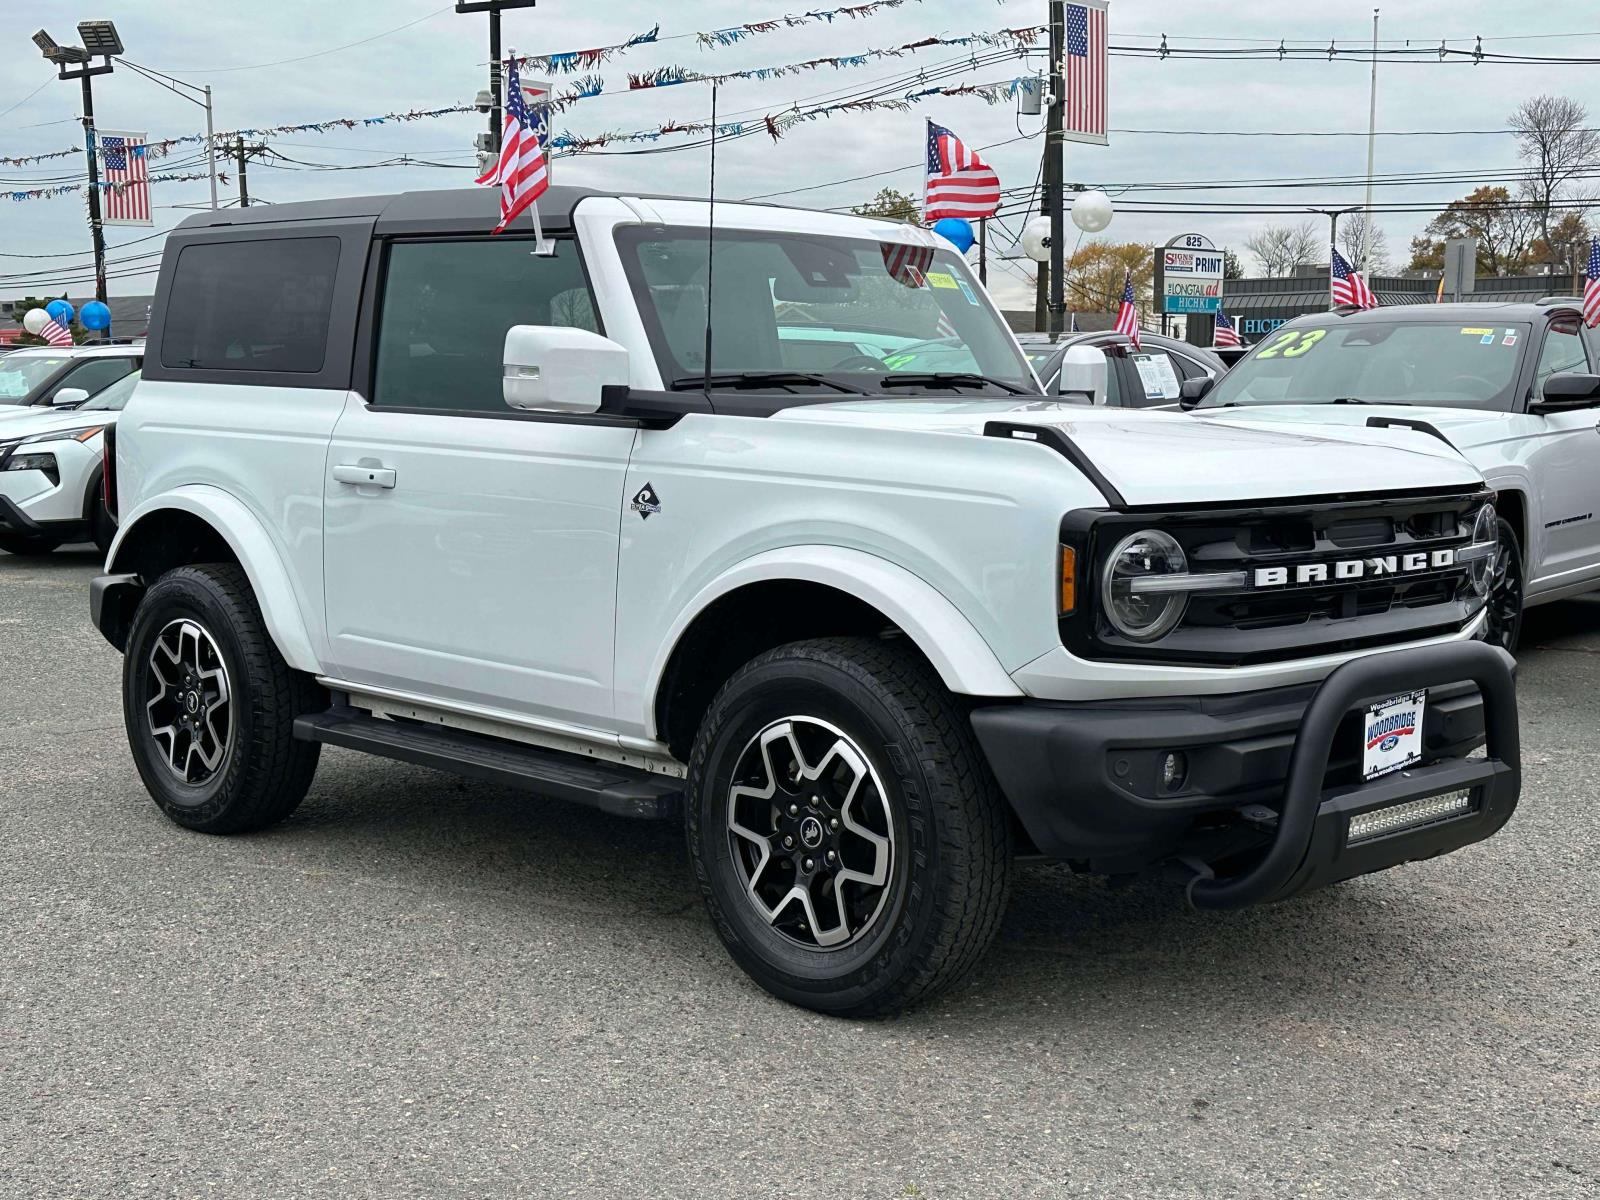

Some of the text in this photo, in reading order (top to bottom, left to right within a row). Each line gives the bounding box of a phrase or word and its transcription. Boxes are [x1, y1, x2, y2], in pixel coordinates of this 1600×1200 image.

[1186, 236, 1202, 247] 825
[1166, 252, 1194, 266] SIGNS
[1195, 256, 1222, 273] PRINT
[1172, 280, 1220, 296] LONGTAIL ad
[1178, 297, 1209, 309] HICHKI
[1255, 329, 1327, 360] 23
[1254, 549, 1454, 587] BRONCO
[1367, 711, 1416, 743] WOODBRIDGE
